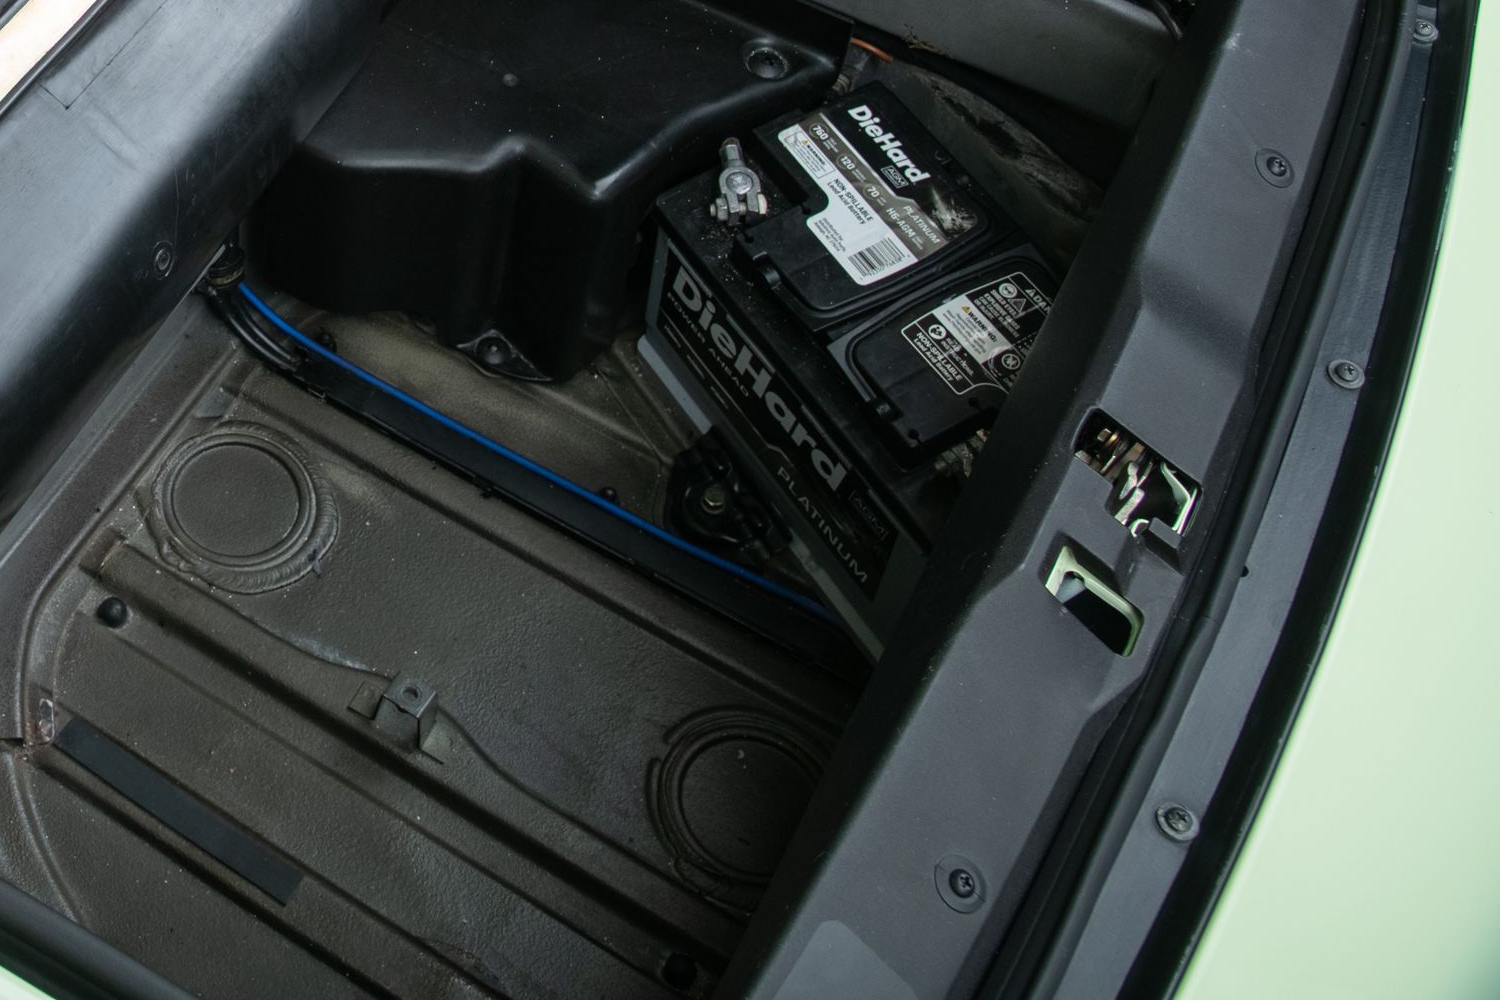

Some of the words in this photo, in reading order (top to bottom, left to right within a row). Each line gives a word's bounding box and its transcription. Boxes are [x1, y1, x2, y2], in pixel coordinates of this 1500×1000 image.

[812, 125, 829, 140] 760
[847, 103, 932, 185] DieHard
[839, 155, 855, 170] 120
[887, 168, 906, 185] AGM
[826, 181, 841, 194] Lead
[837, 193, 851, 205] Acid
[846, 204, 867, 225] Battery
[833, 178, 873, 221] NON-SPILLABLE
[866, 185, 880, 197] 70
[885, 207, 916, 238] H6-AGM
[902, 205, 941, 244] PLATINUM
[666, 291, 706, 344] POWER
[706, 346, 749, 398] AHEAD
[912, 338, 928, 352] Lead
[924, 350, 938, 363] Acid
[934, 361, 955, 381] Battery
[916, 332, 963, 381] NON-SPILLABLE
[671, 264, 848, 492] DieHard
[777, 465, 868, 583] PLATINUM
